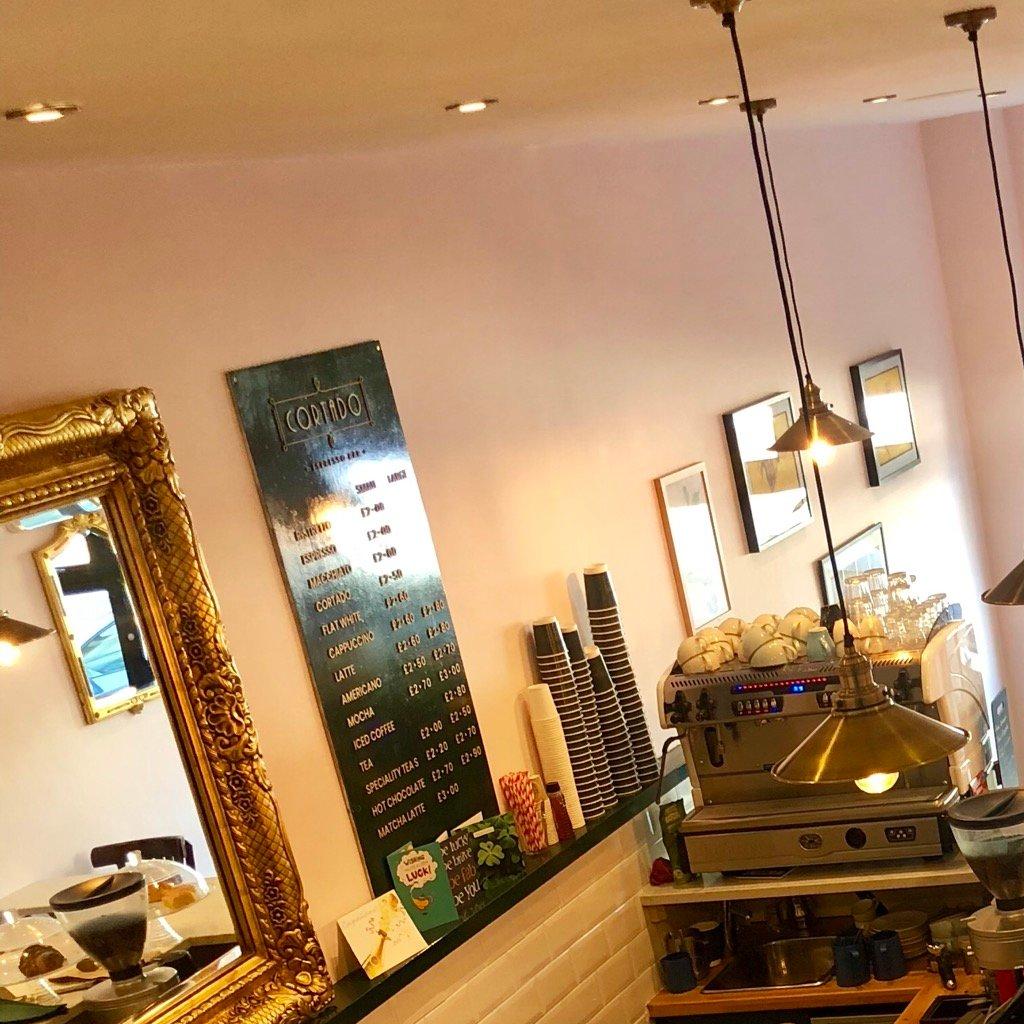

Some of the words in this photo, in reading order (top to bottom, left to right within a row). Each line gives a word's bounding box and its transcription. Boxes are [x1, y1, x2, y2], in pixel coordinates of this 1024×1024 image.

[286, 393, 362, 433] CORTADO
[300, 544, 337, 565] ESPRESSO
[315, 591, 350, 612] CORTADO
[321, 620, 340, 637] FLAT
[339, 611, 362, 629] WHITE
[328, 630, 375, 659] CAPPUCCINO
[334, 664, 357, 682] LATTE
[341, 678, 382, 705] AMERICANO
[347, 707, 375, 728] MOCHA
[353, 733, 371, 750] ICED
[370, 720, 396, 741] COFFEE
[359, 758, 374, 772] TEA
[365, 767, 402, 795] SPECIALITY
[401, 757, 419, 773] TEAS
[371, 800, 386, 817] HOT
[387, 778, 426, 806] CHOCOLATE
[377, 817, 406, 839] MATCHA
[407, 803, 426, 820] LATTE
[406, 865, 431, 882] LUCK!
